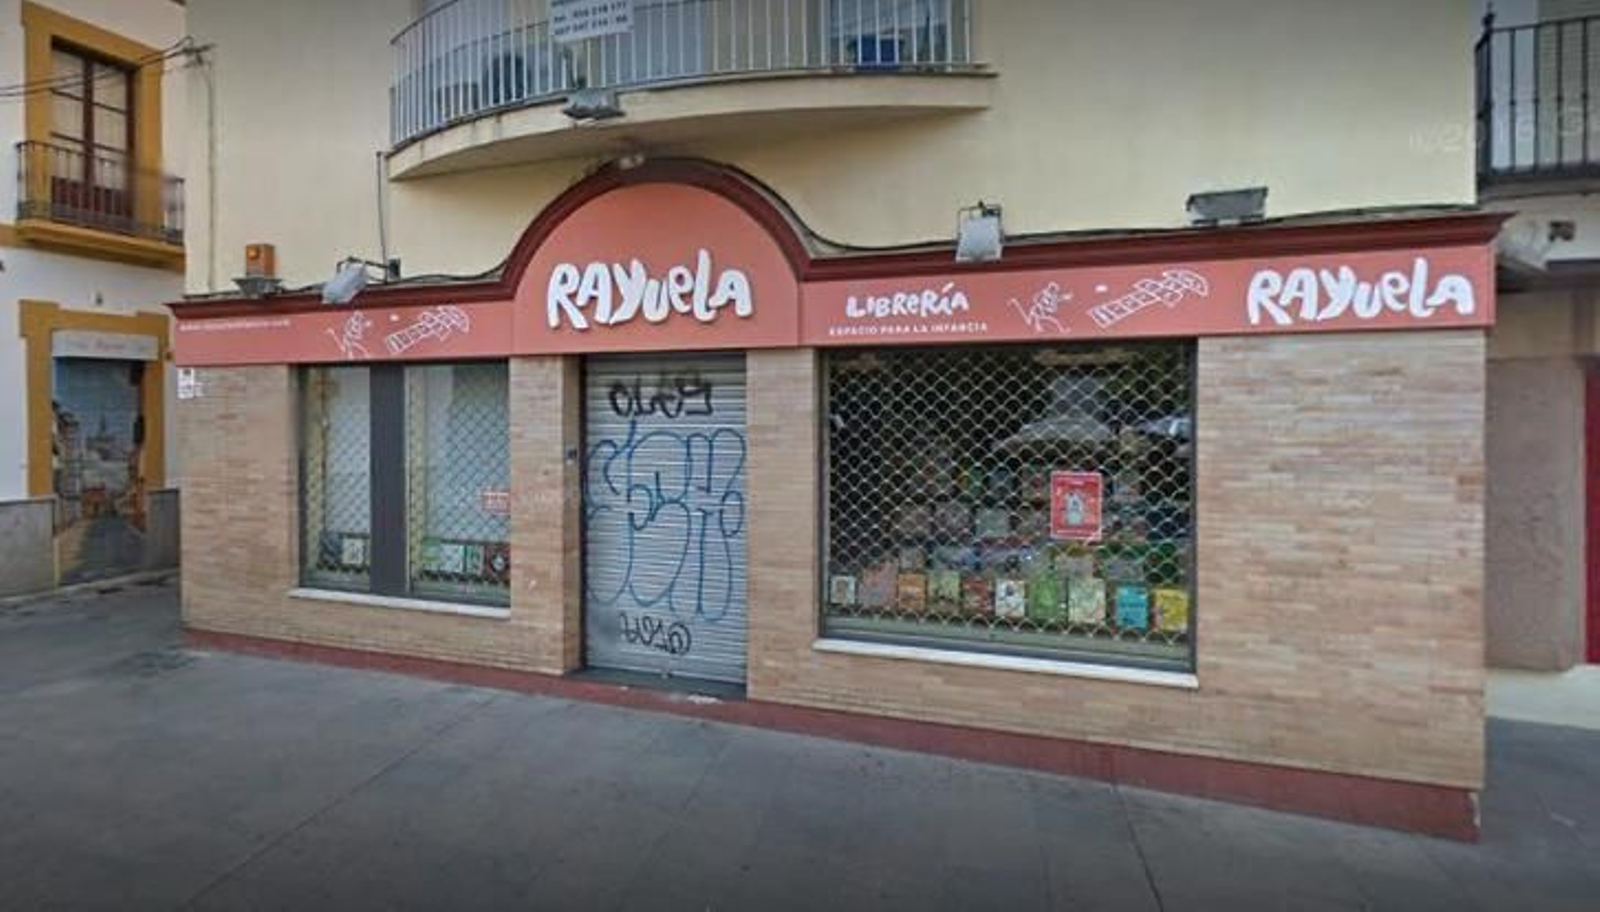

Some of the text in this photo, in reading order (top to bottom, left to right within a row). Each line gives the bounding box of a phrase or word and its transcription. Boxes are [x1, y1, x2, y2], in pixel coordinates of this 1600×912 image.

[829, 322, 988, 336] ESPACIO PARA LA INFANCIA
